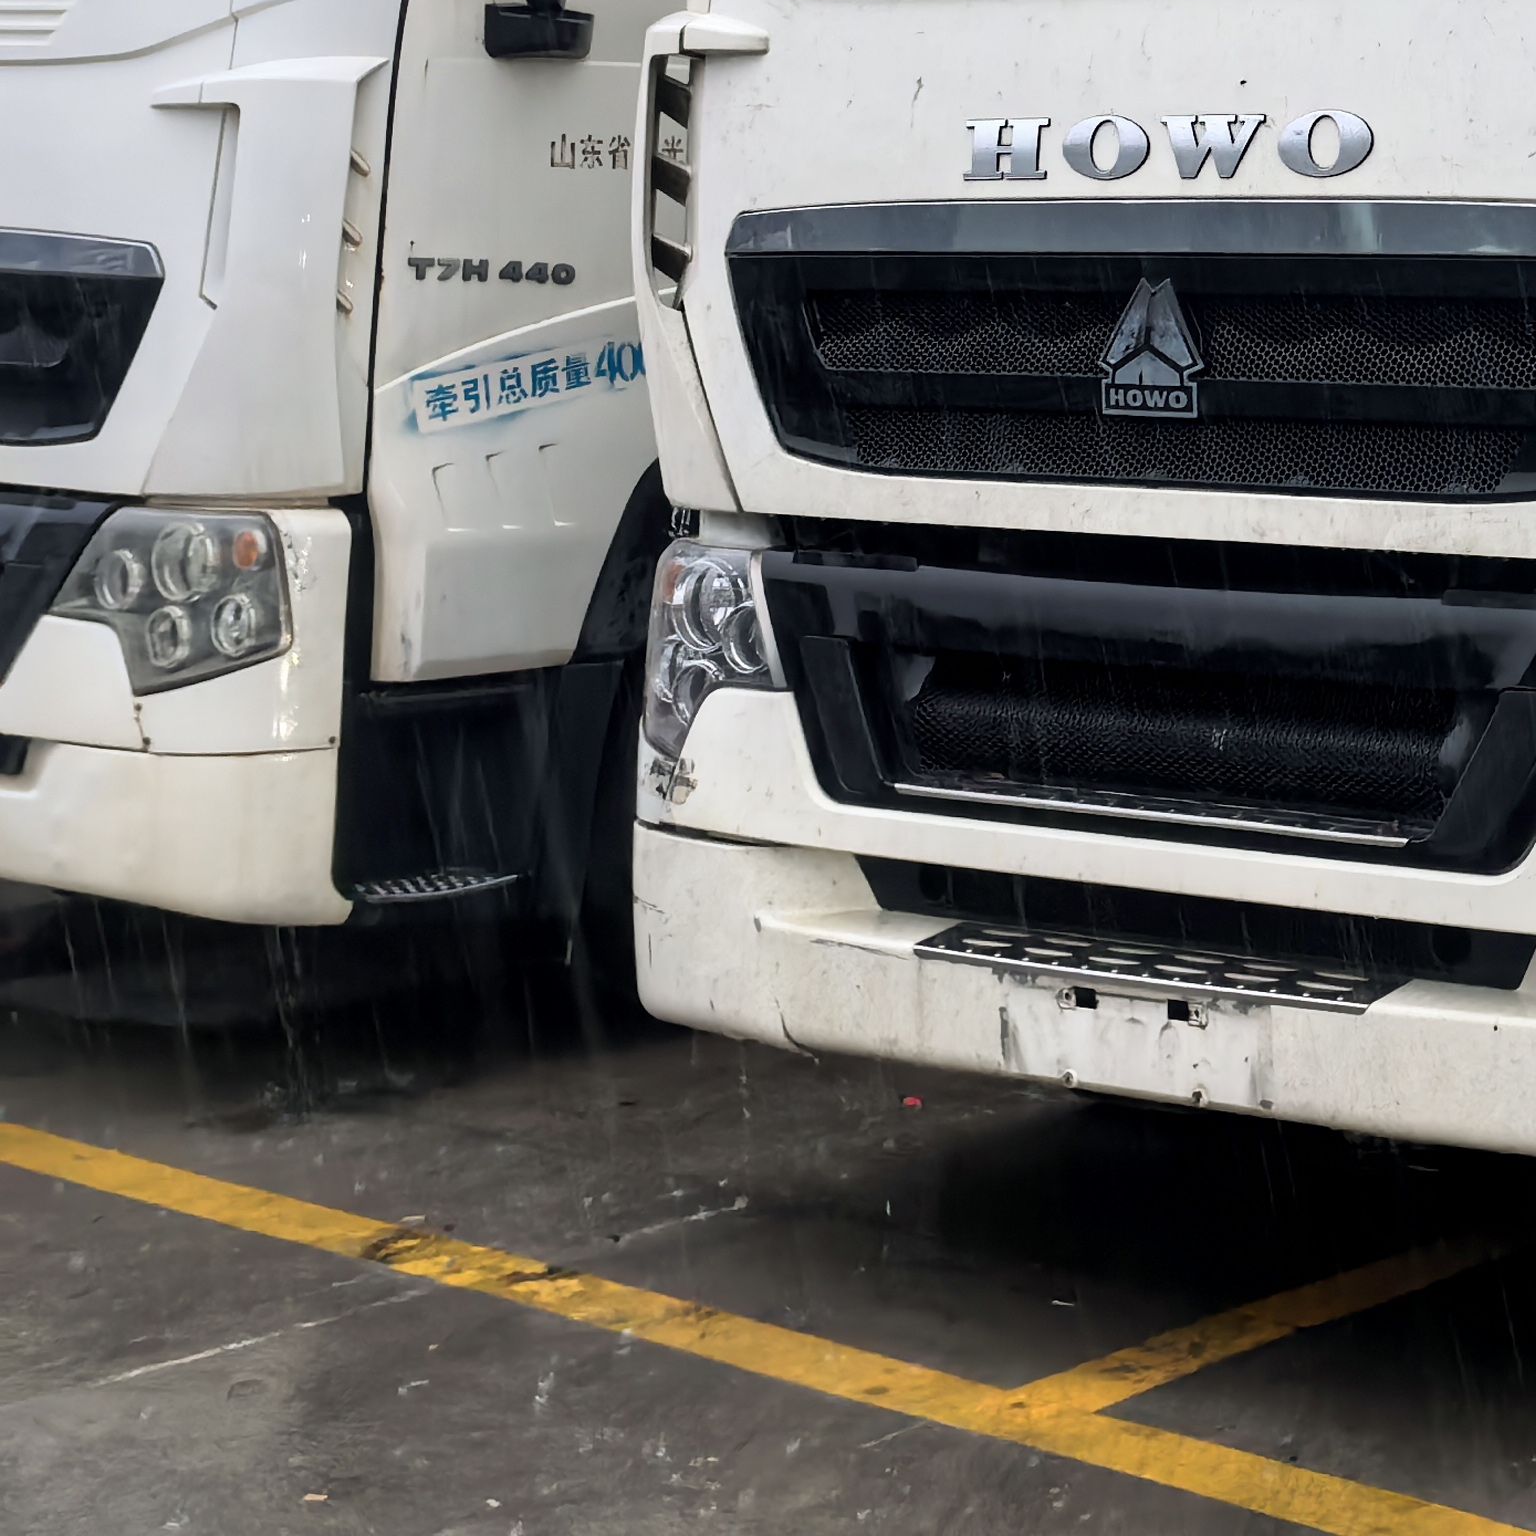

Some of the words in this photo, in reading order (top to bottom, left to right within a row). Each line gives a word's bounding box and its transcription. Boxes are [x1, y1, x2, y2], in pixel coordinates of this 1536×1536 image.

[962, 108, 1375, 181] HOWO
[408, 257, 489, 282] T7H
[499, 260, 577, 285] 440
[1107, 388, 1189, 411] HOWO
